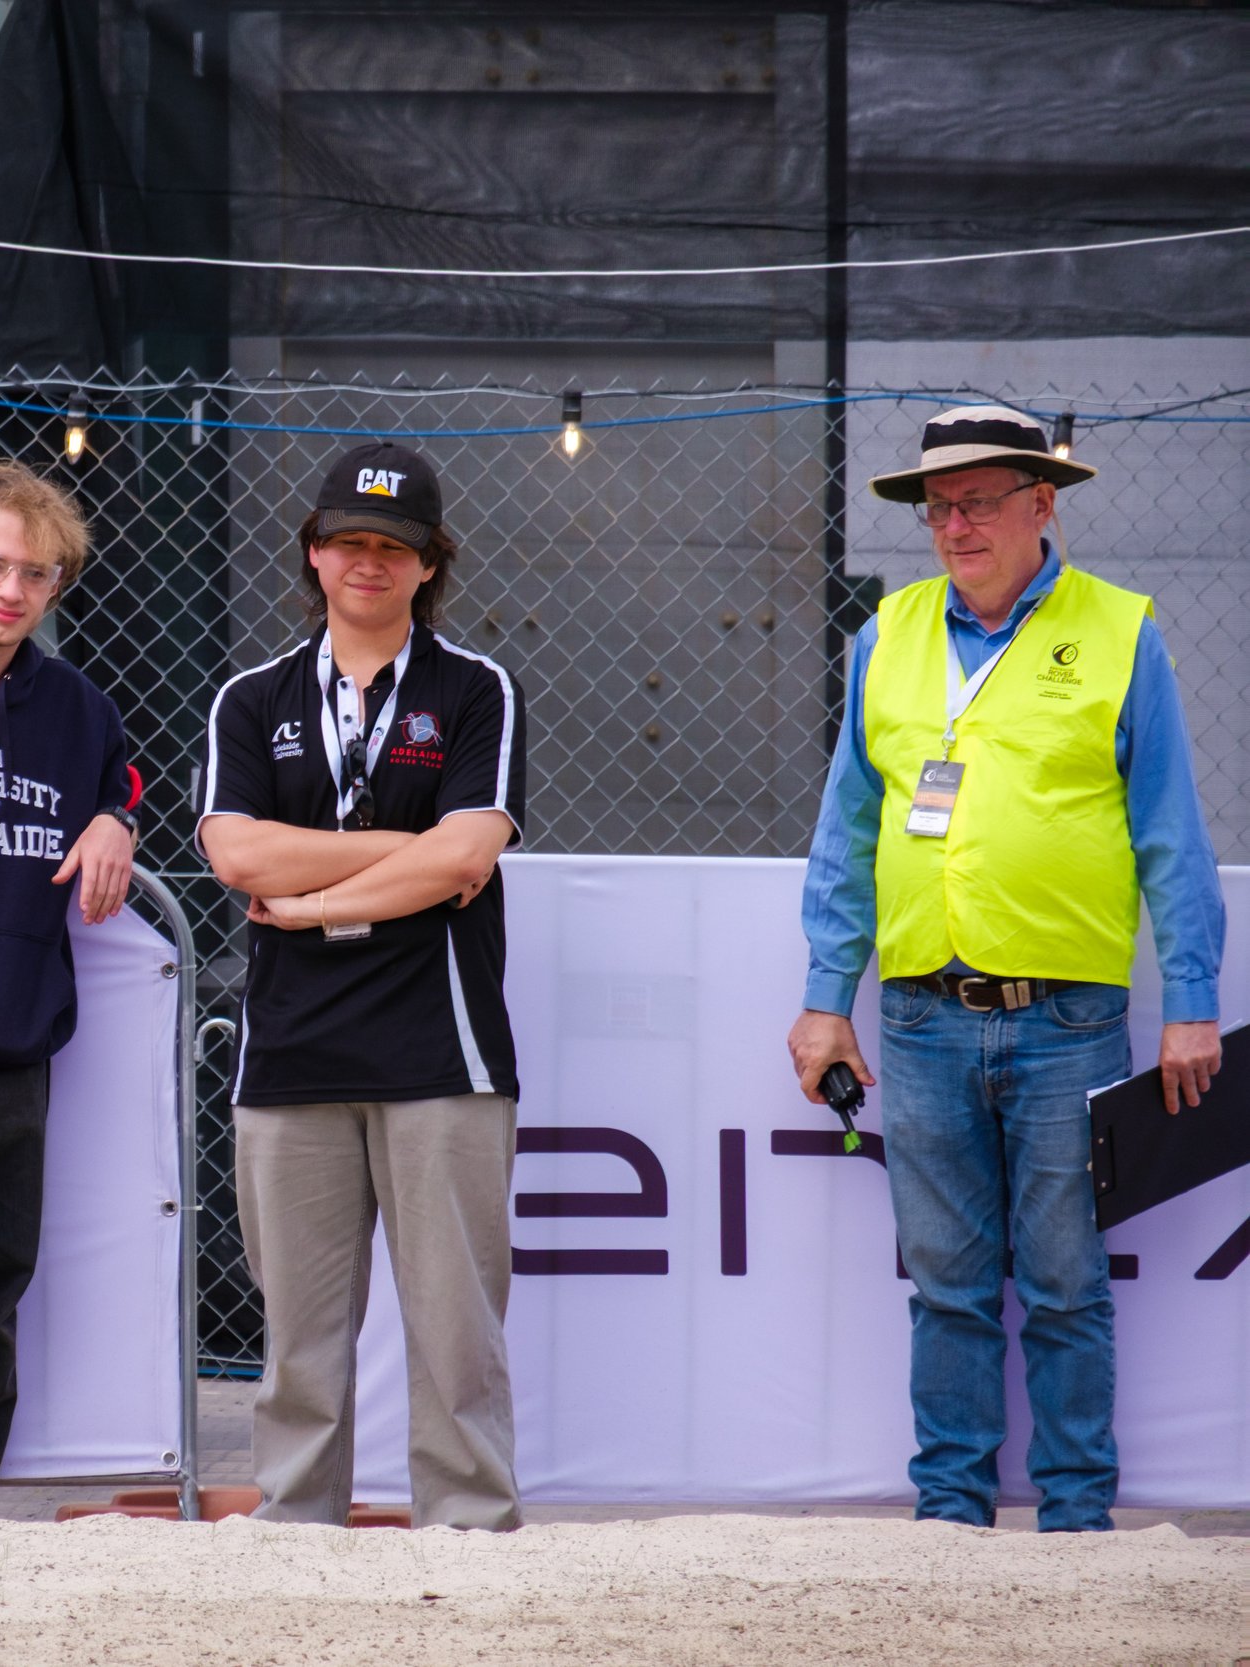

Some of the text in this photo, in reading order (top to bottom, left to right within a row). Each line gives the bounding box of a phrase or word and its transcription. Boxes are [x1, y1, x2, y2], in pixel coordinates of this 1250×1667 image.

[356, 468, 403, 497] CAT
[1036, 674, 1083, 685] CHALLENGE
[273, 742, 300, 752] Adelaide
[273, 748, 304, 760] University
[390, 747, 443, 760] ADELAIDE
